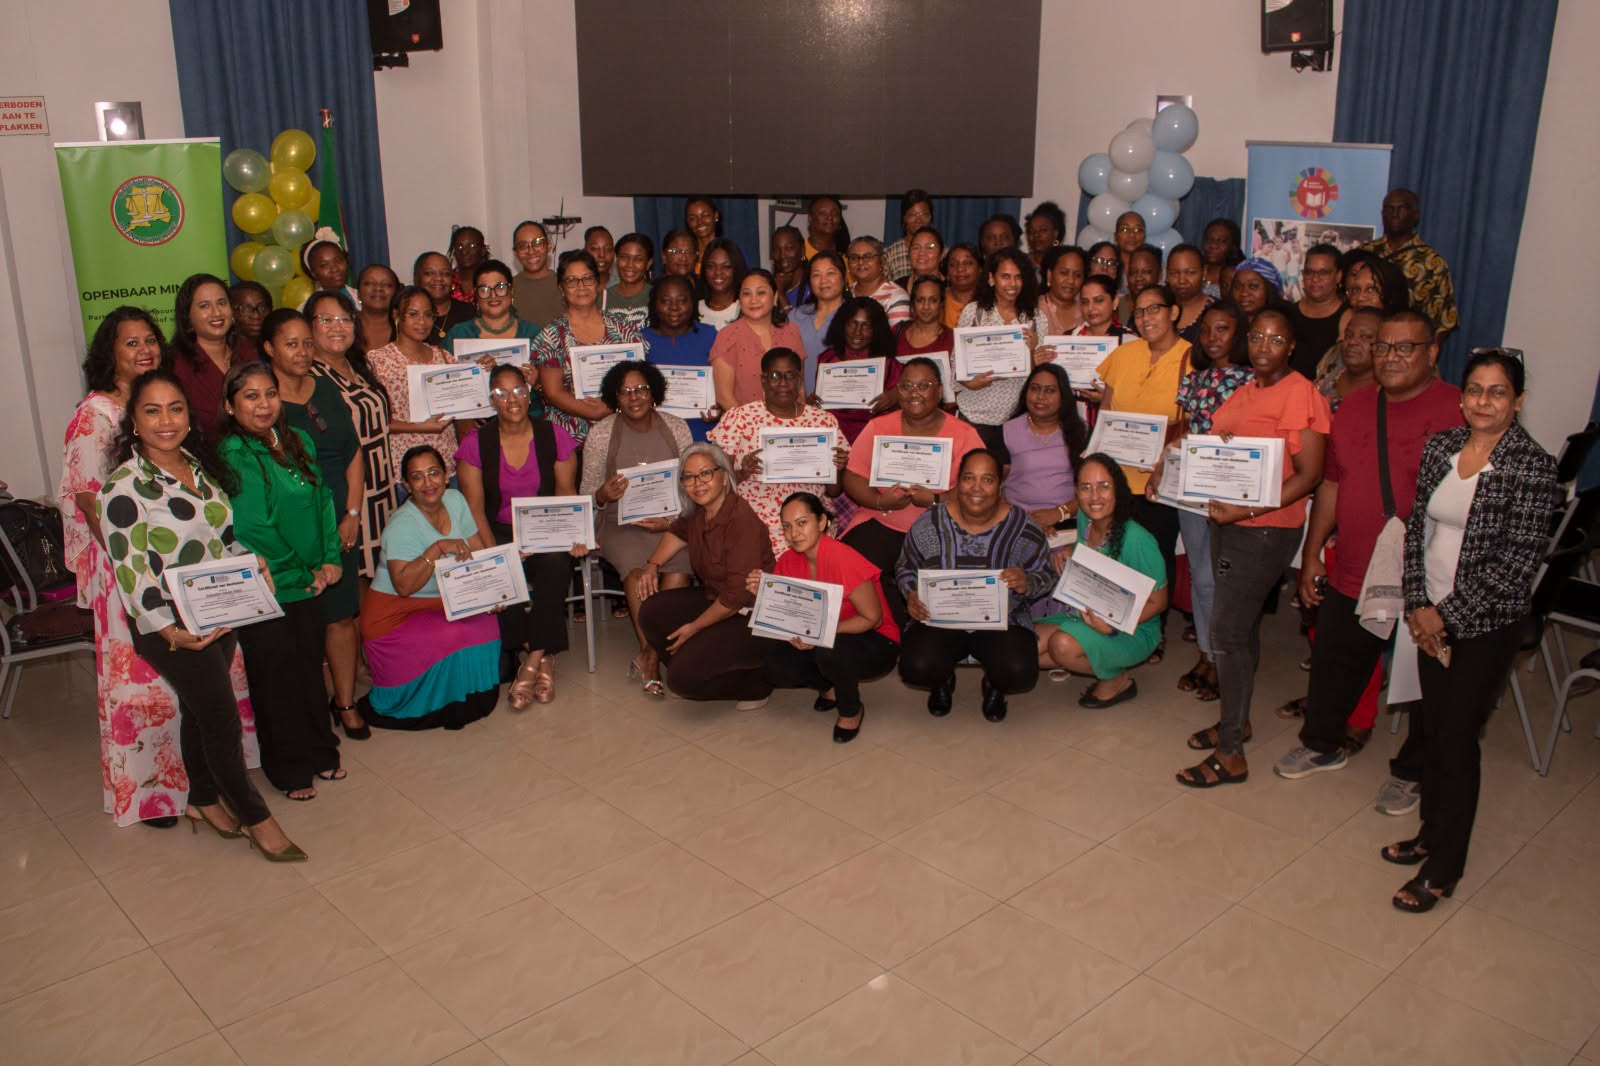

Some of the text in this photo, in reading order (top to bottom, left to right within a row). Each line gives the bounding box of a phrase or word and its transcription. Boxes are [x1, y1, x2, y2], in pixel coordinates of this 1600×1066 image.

[0, 101, 43, 109] ERBODEN
[2, 112, 22, 120] AAN
[0, 123, 43, 131] PLAKKEN
[82, 286, 157, 301] OPENBAAR
